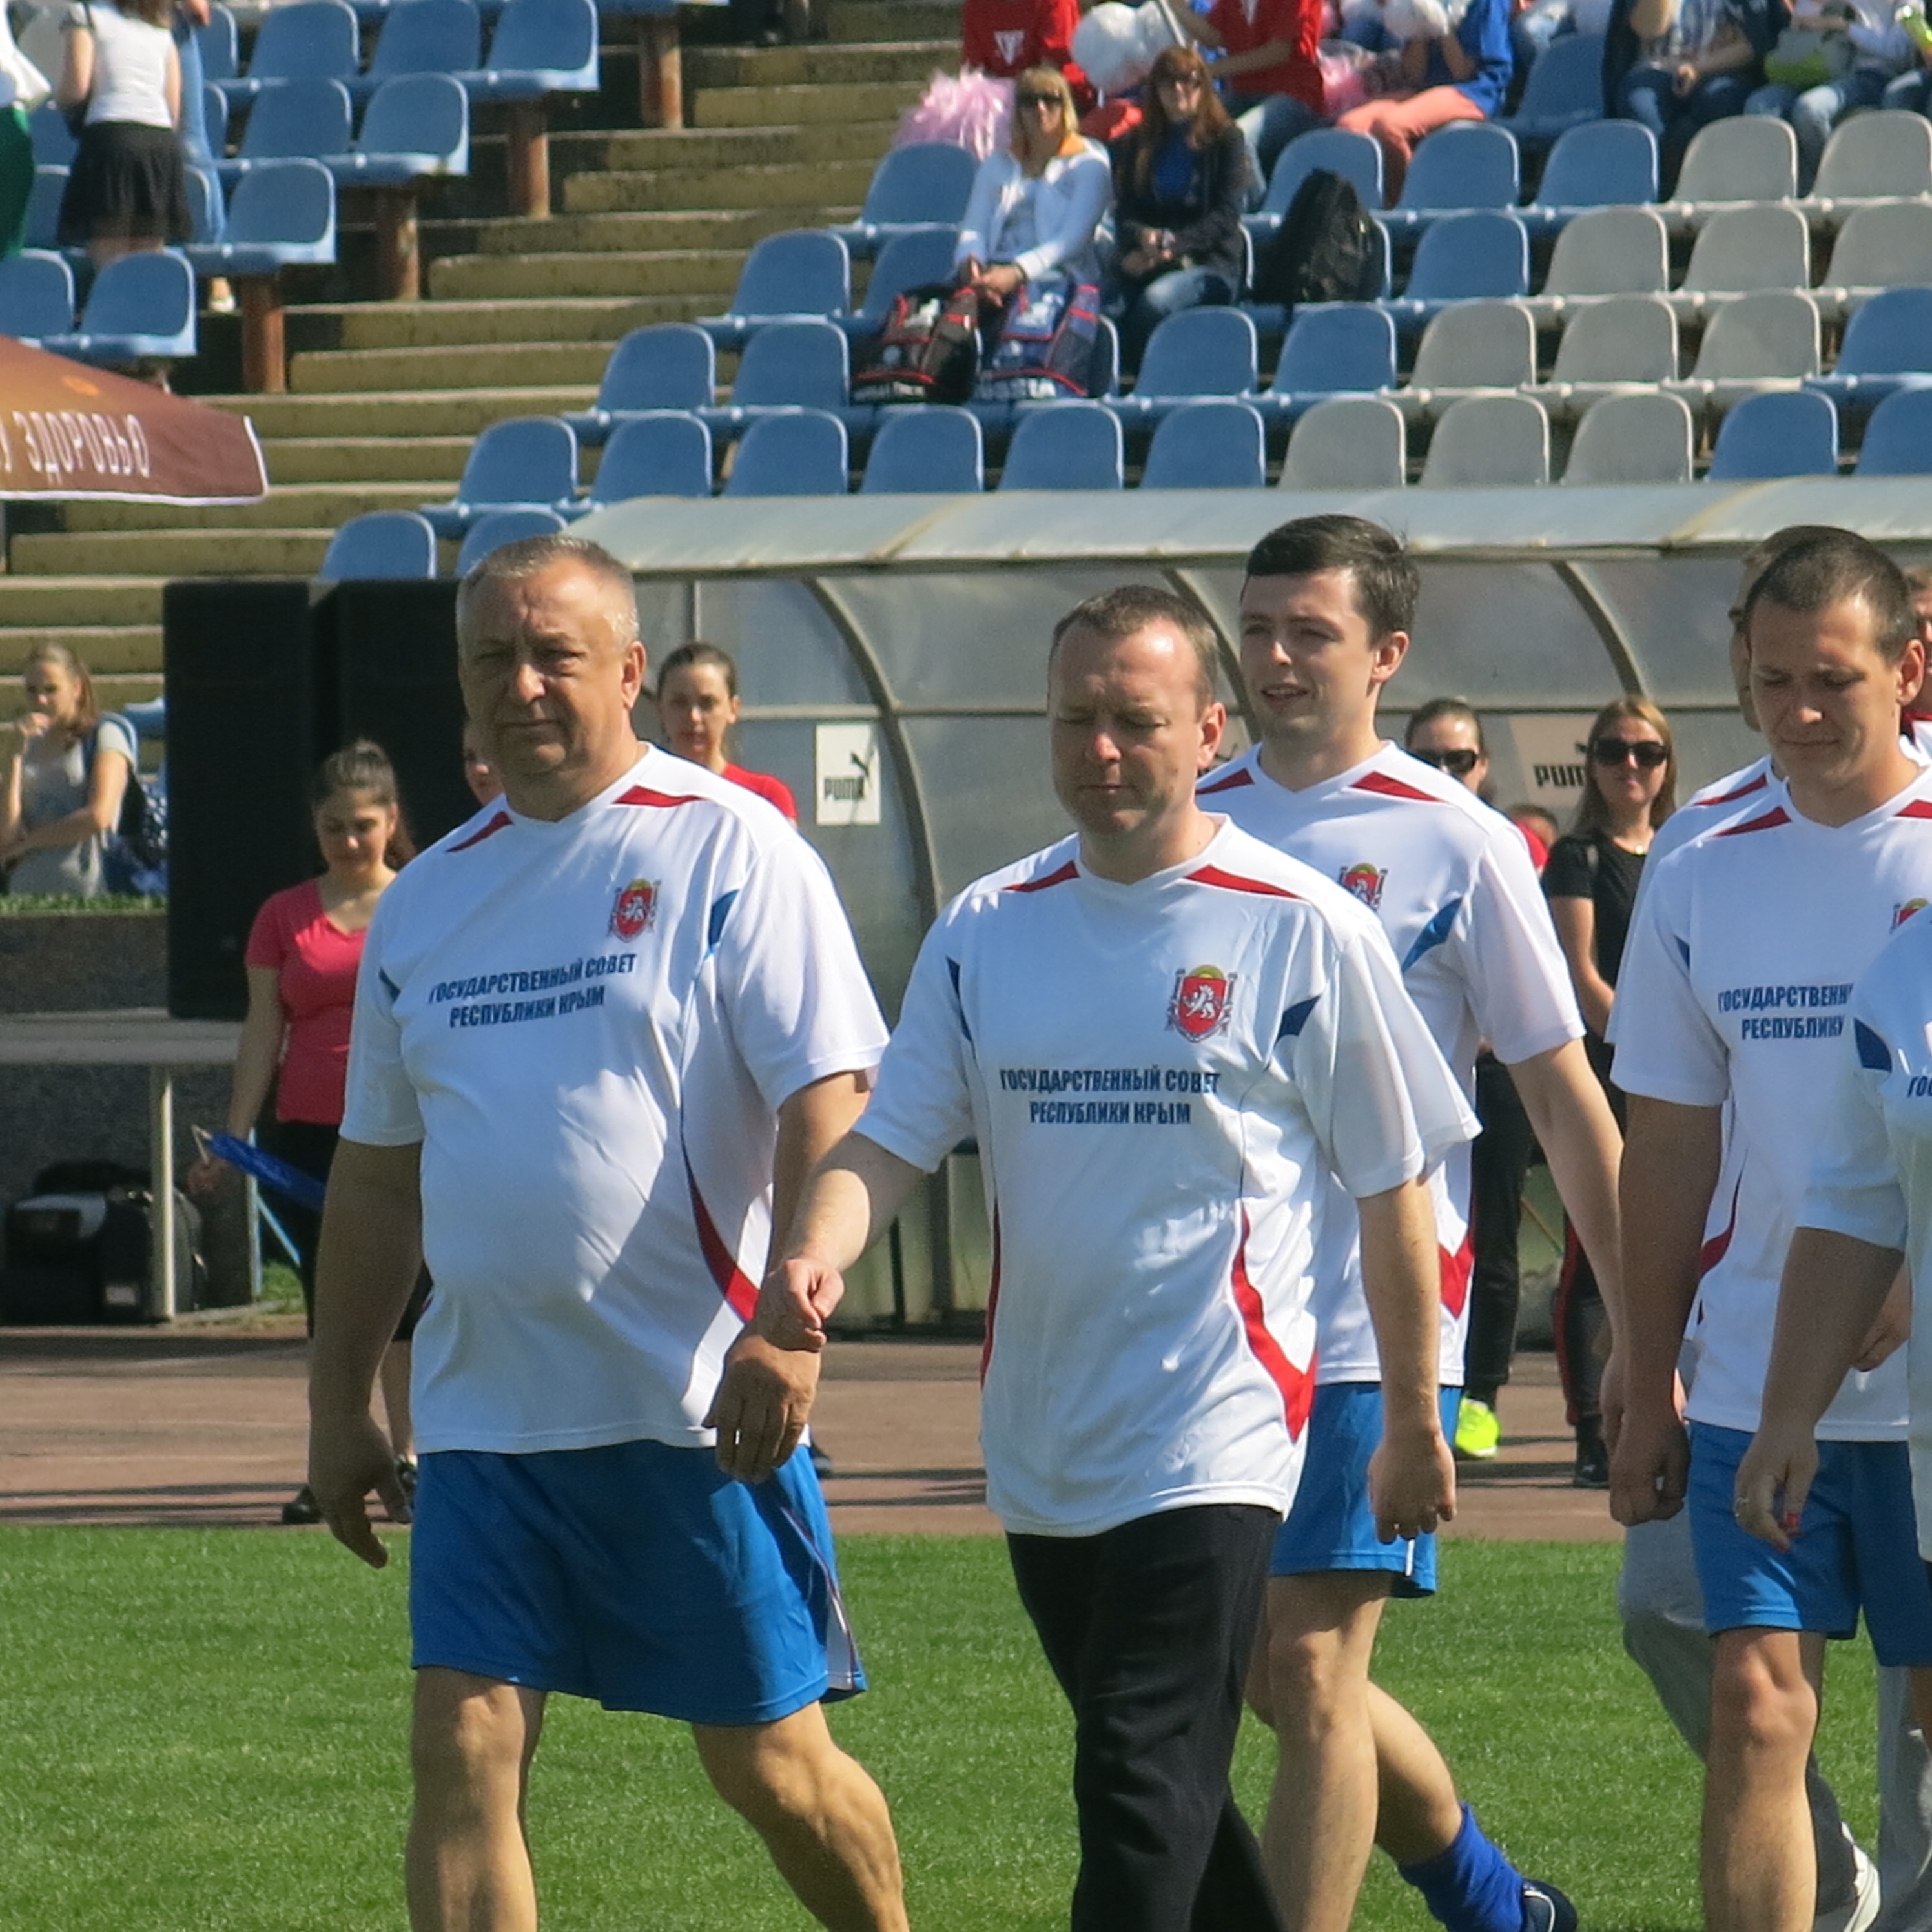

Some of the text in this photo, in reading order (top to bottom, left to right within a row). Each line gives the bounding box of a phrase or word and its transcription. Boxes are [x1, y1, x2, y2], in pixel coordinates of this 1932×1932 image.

[824, 777, 865, 801] PUMA
[1533, 765, 1586, 788] PUM
[428, 952, 636, 1003] ГОСУДАРСТВЕННЫЙ СОВЕТ
[450, 985, 606, 1028] РЕСПУБЛИКИ КРЫМ
[1717, 983, 1854, 1014] ГОСУДАРСТВЕНН
[1000, 1064, 1221, 1094] ГОСУДАРСТВЕННЫЙ СОВЕТ
[1029, 1100, 1191, 1124] РЕСПУБЛИКИ КРЫМ
